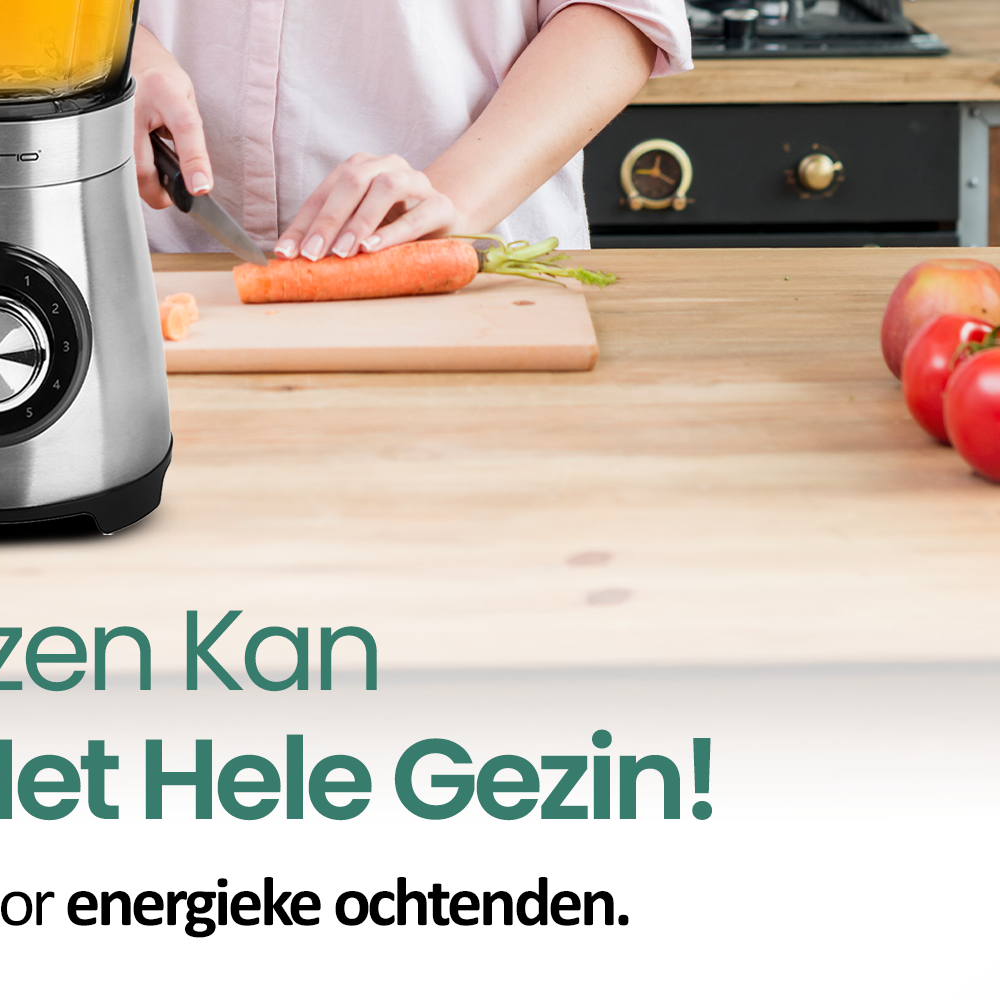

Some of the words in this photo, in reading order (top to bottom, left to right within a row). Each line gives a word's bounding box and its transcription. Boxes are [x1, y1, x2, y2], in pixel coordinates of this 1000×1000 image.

[24, 276, 30, 286] 1
[51, 303, 59, 314] 2
[63, 341, 70, 352] 3
[52, 379, 61, 390] 4
[26, 407, 33, 418] 5
